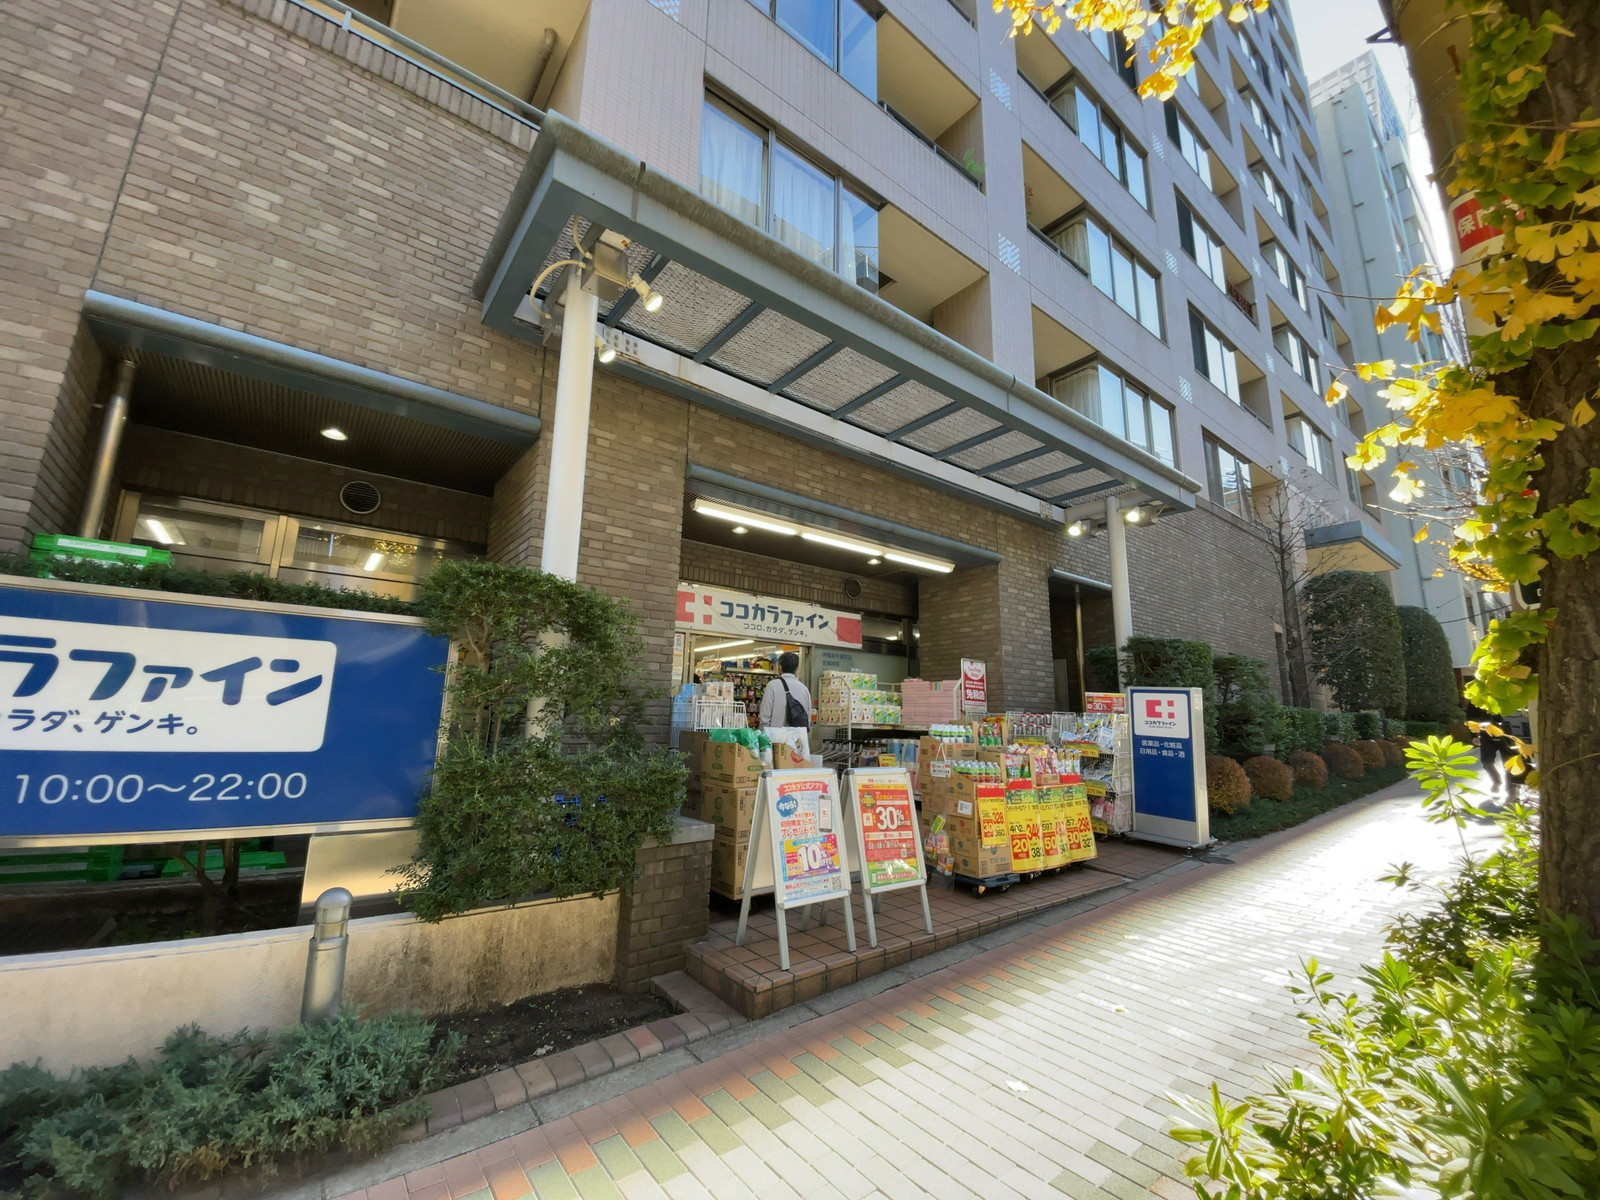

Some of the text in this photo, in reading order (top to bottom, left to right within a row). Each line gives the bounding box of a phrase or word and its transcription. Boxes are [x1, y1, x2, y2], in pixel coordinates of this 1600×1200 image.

[720, 600, 830, 630] ココカラファイン
[0, 634, 324, 707] ラファイン
[965, 689, 985, 700] 免税店
[1141, 740, 1183, 749] 医薬品・化粧品
[1140, 748, 1185, 758] 日用品・食品・酒
[983, 823, 993, 832] 30
[1010, 824, 1024, 833] 402
[1041, 822, 1053, 832] 597
[1044, 835, 1057, 850] 50
[1067, 832, 1079, 844] 30
[1013, 838, 1028, 853] 20
